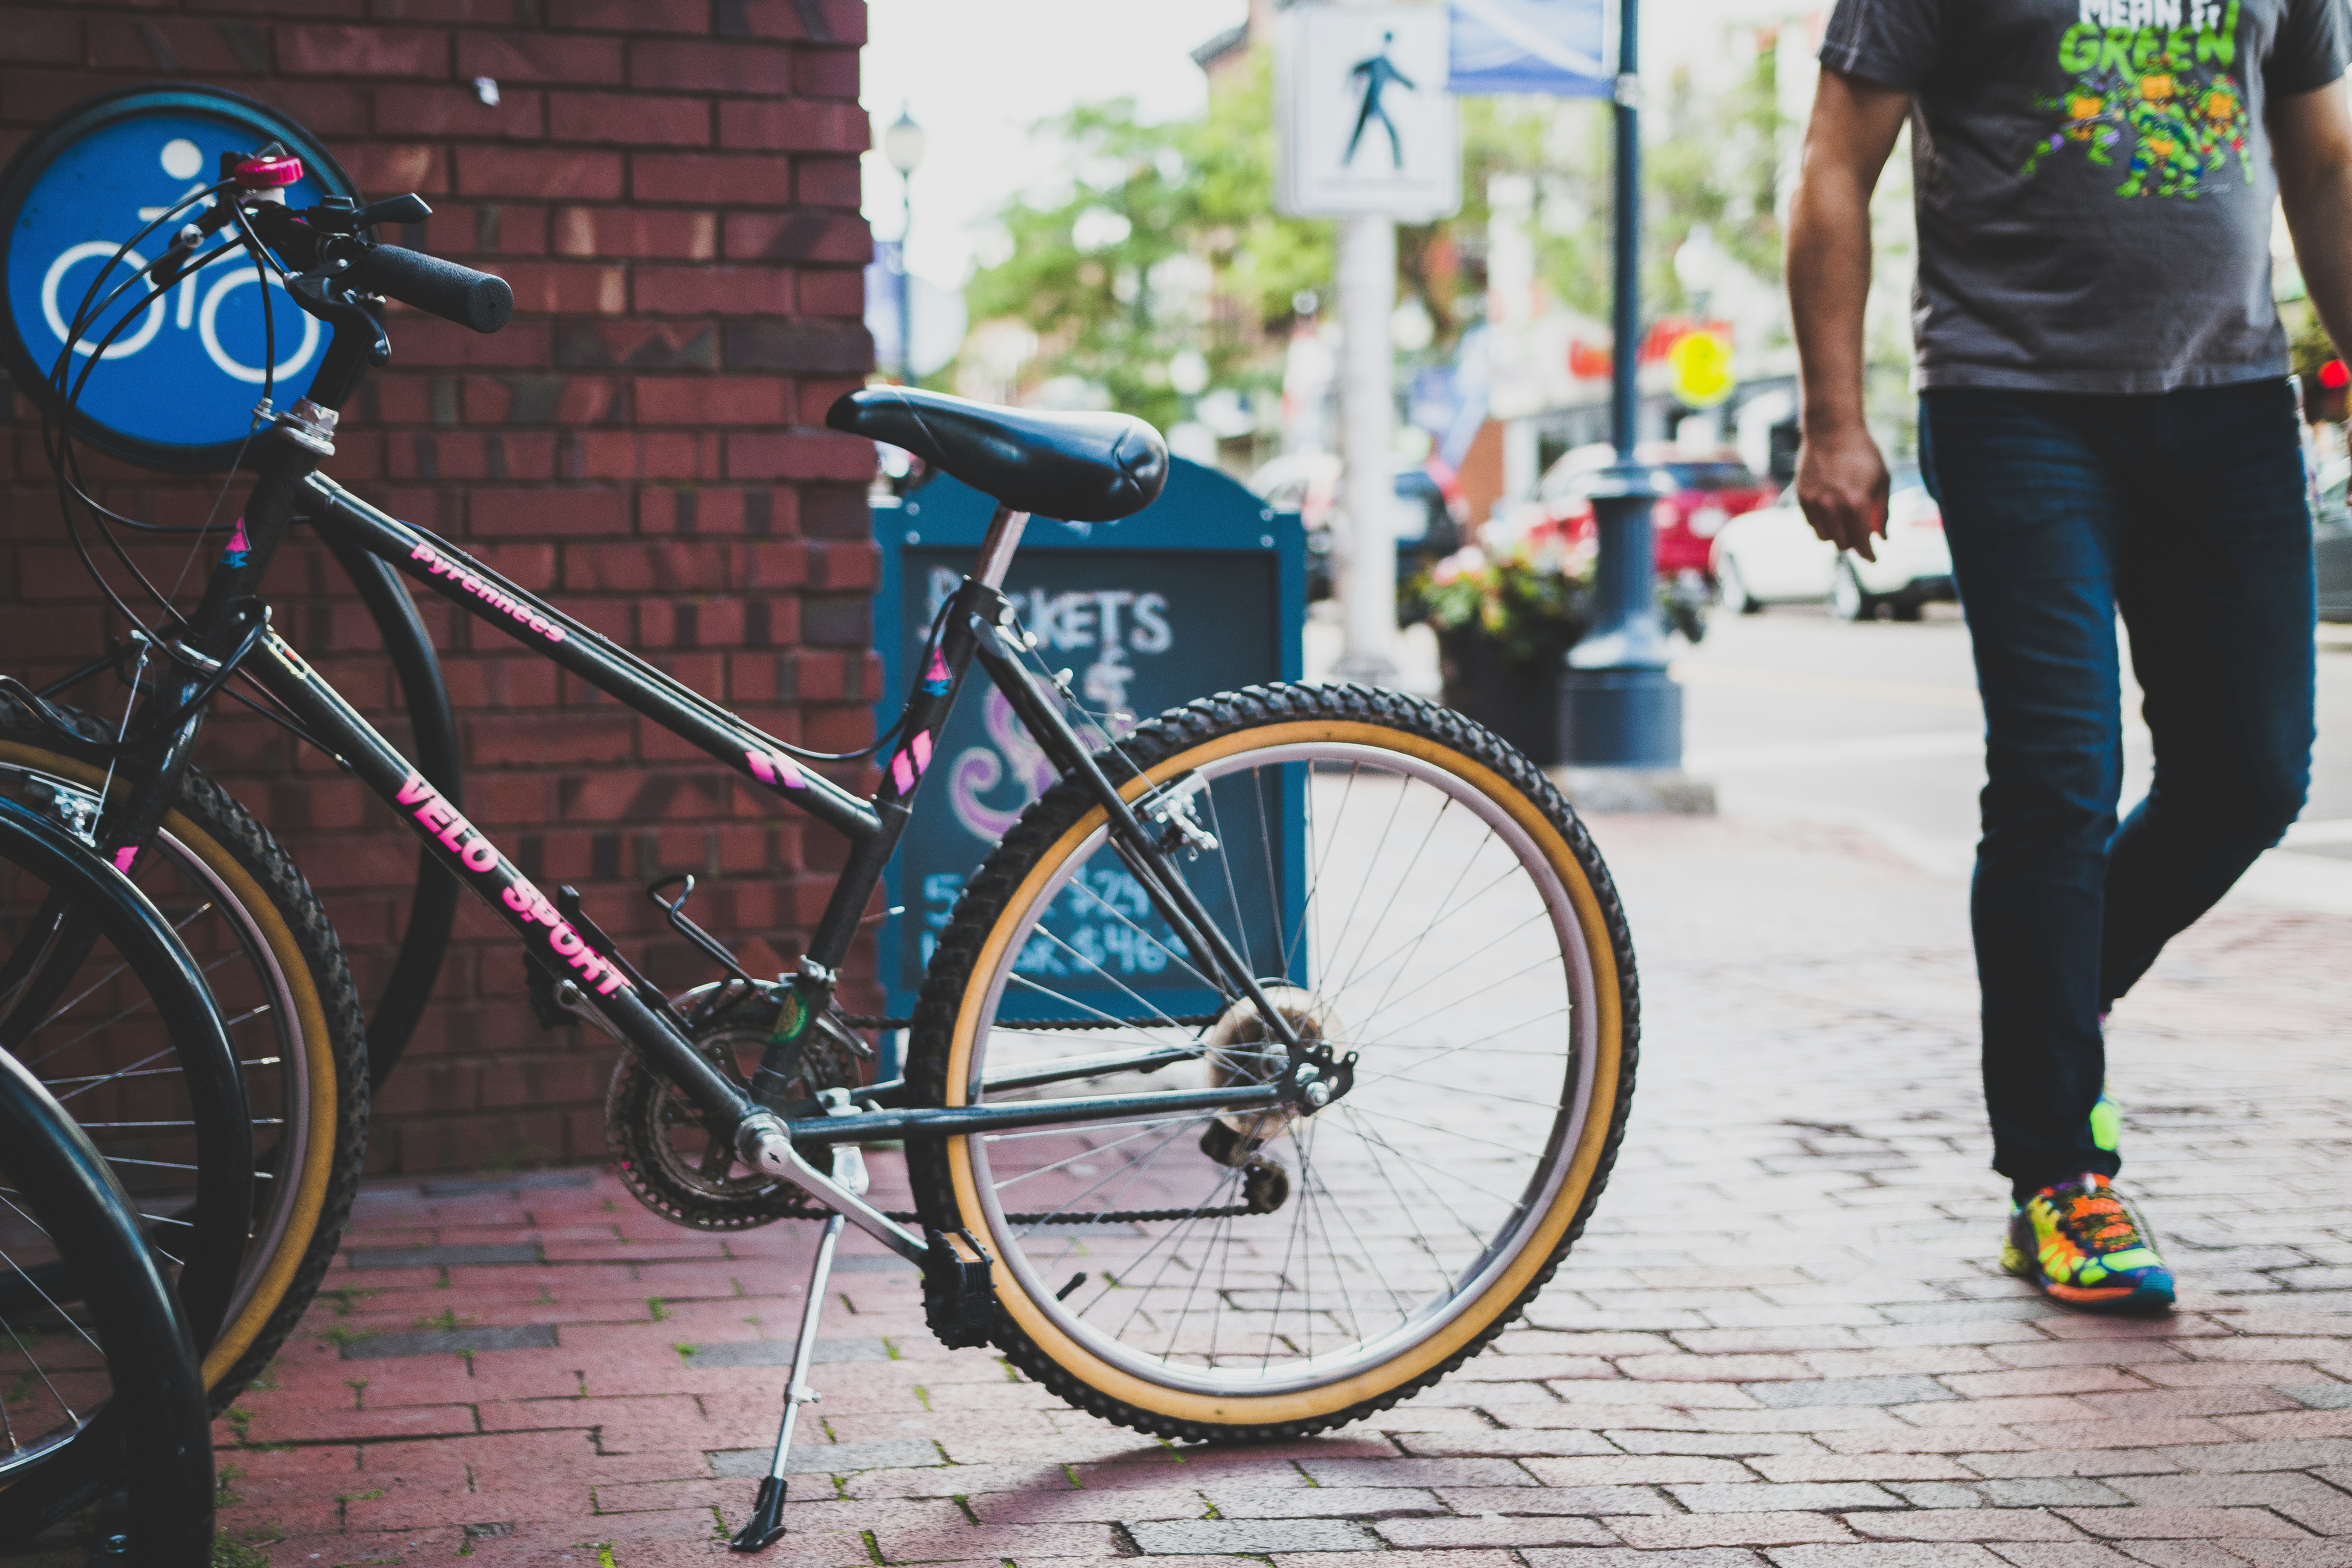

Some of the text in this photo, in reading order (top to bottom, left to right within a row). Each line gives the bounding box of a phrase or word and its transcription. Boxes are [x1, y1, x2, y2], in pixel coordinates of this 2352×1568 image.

[2058, 0, 2241, 84] GREEN
[917, 566, 1173, 654] KETS
[396, 771, 633, 995] VELO SPORT
